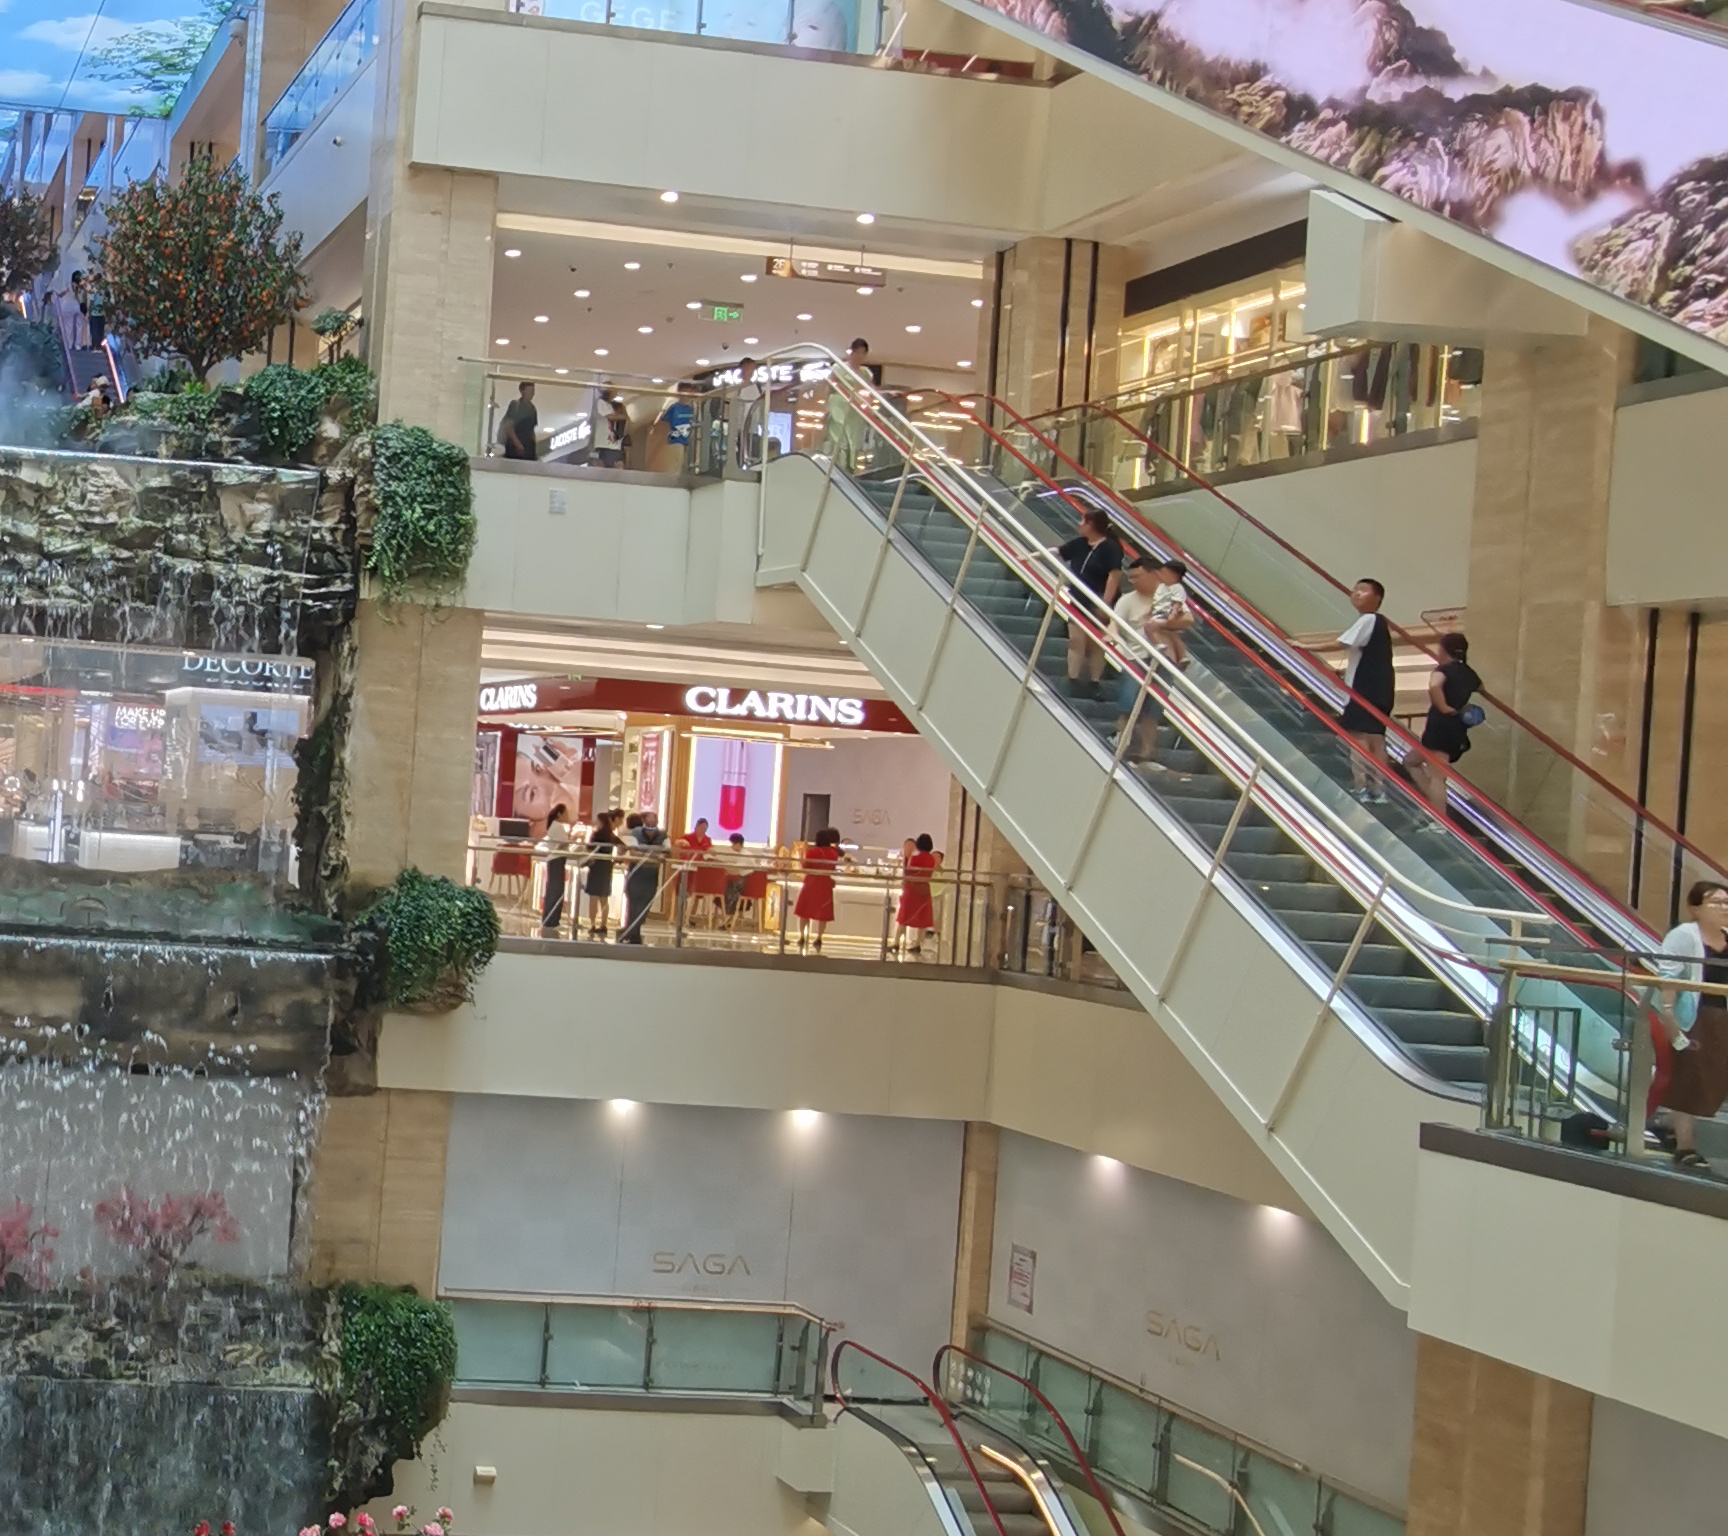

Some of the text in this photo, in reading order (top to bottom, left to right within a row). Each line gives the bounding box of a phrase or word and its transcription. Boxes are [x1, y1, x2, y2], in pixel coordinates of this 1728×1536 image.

[480, 684, 537, 711] CLARINS
[685, 686, 866, 726] CLARINS
[653, 1251, 751, 1275] SAGA
[1146, 1310, 1221, 1361] SAGA
